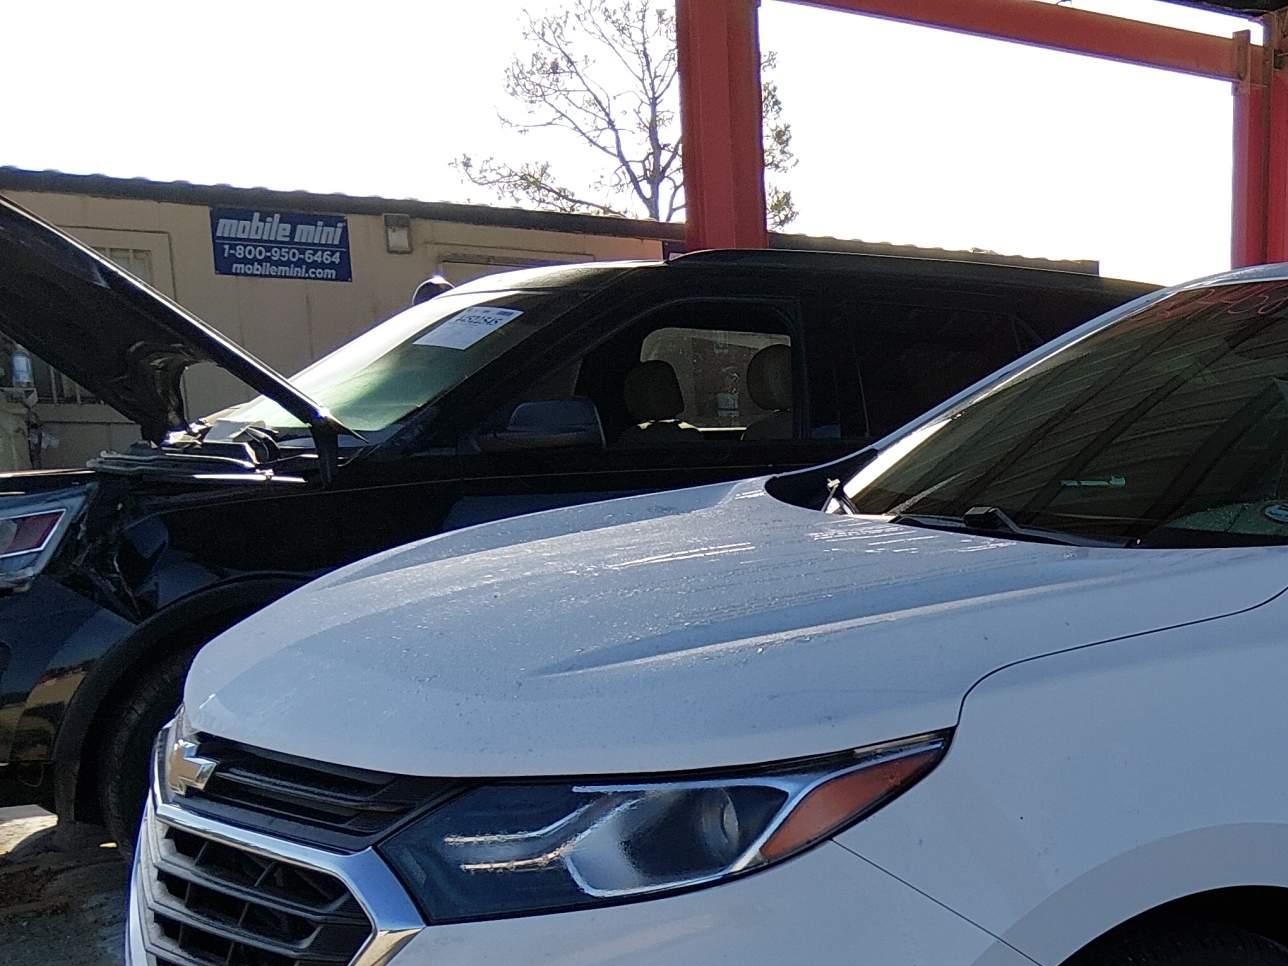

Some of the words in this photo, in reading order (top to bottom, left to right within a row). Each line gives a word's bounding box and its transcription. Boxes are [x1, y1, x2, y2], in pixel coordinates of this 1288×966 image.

[216, 212, 291, 241] mobile
[294, 221, 344, 244] mini
[223, 245, 340, 264] 1-800-950-6464
[232, 261, 336, 280] mobilemini.com
